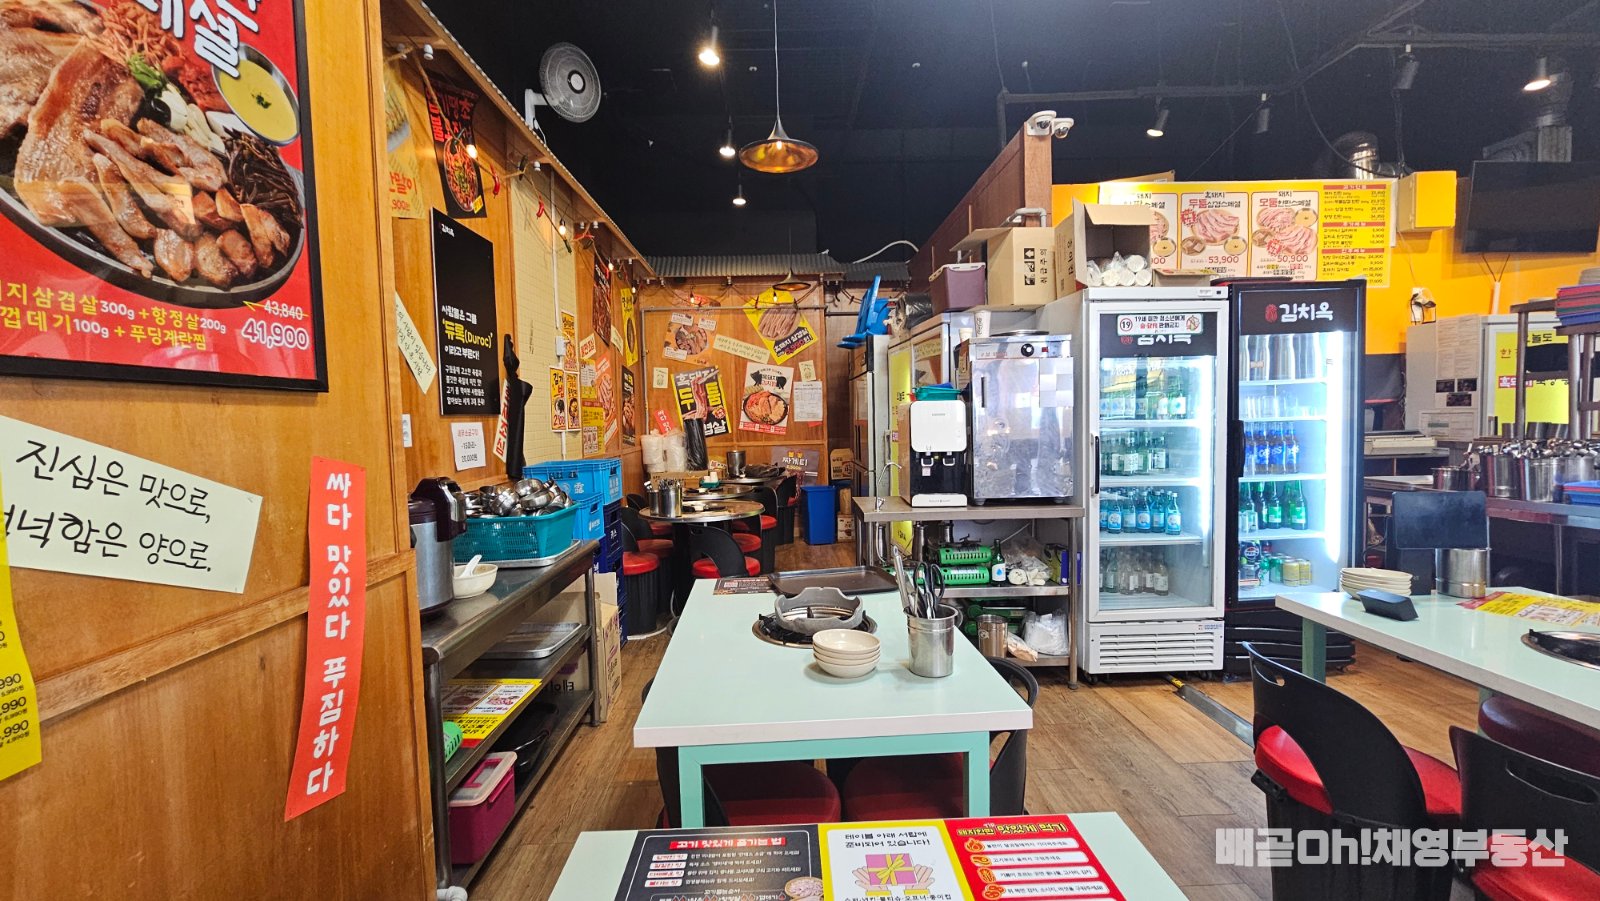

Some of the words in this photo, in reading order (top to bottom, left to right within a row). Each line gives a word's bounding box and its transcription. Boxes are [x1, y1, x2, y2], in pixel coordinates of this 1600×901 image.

[1208, 255, 1240, 264] 53,900
[1277, 254, 1309, 264] 50,900
[0, 279, 135, 321] 지삼겹살300g
[441, 304, 466, 322] 사람들은
[1278, 302, 1334, 323] 김치옥
[241, 317, 310, 350] 41,900
[1122, 321, 1131, 329] 19
[130, 323, 207, 350] 푸딩계란찜
[16, 440, 129, 496] 진심은
[139, 474, 212, 524] 맛으로,
[326, 473, 352, 531] 싸다
[139, 532, 212, 573] 양으로.
[324, 544, 352, 640] 맛있다
[305, 656, 347, 796] 푸짐하다
[844, 832, 874, 840] 테이블
[876, 831, 896, 839] 아래
[898, 830, 928, 838] 서랍에
[996, 823, 1038, 834] 맛있게
[1038, 822, 1068, 832] 먹기
[676, 840, 698, 849] 고기
[701, 839, 735, 849] 맛있게
[736, 838, 769, 847] 즐기는
[770, 837, 783, 846] 법
[845, 840, 885, 849] 준비되어
[886, 838, 931, 847] 있습니다!
